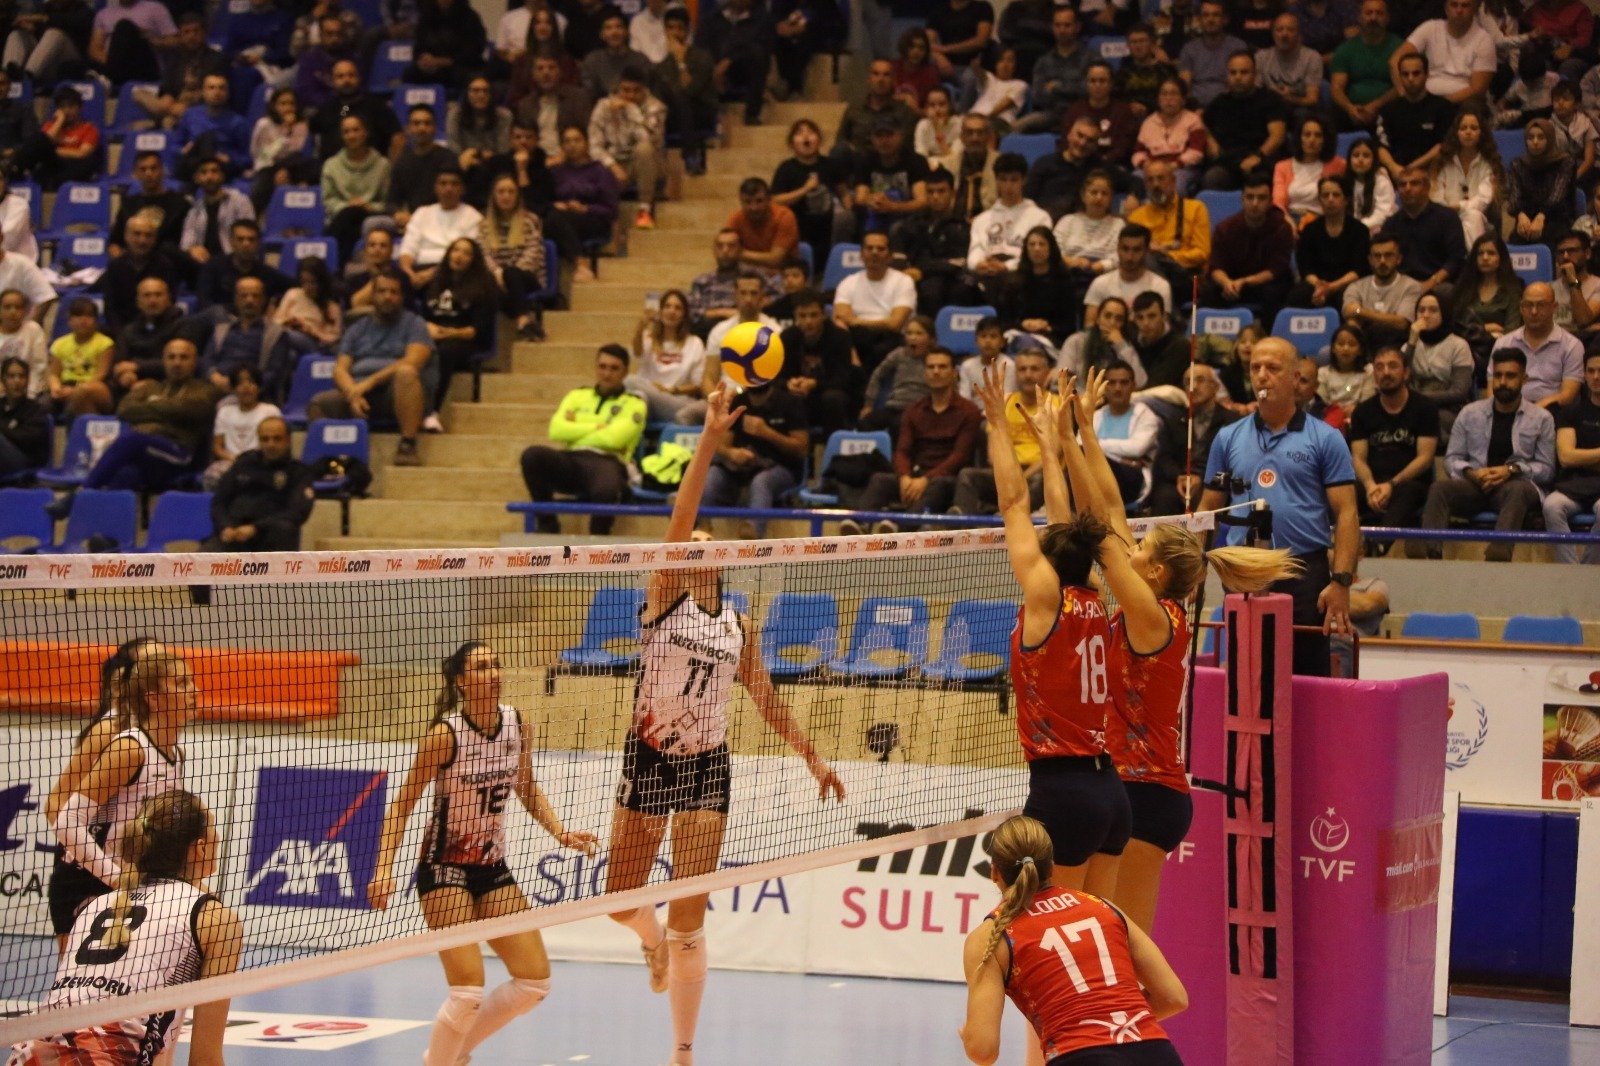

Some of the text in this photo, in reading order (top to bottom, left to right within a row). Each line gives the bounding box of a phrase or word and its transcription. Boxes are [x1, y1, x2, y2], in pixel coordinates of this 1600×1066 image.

[49, 564, 72, 579] TVF
[91, 559, 155, 578] misli.com
[173, 562, 194, 577] TVF
[210, 558, 269, 576] misli.com
[285, 560, 303, 575] TVF
[317, 556, 371, 573] misli.com
[386, 558, 402, 572] TVF
[416, 554, 467, 571] misli.com
[478, 556, 494, 569] TVF
[507, 552, 551, 567] misli.com
[588, 550, 630, 565] misli.com
[642, 551, 655, 564] TVF
[666, 547, 705, 562] misli.com
[737, 544, 773, 558] misli.com
[1075, 634, 1108, 704] 18
[246, 839, 355, 898] AXA
[1299, 856, 1356, 882] TVF
[841, 886, 980, 934] SULT
[1027, 892, 1081, 917] LODA
[75, 904, 148, 965] 8
[1039, 916, 1118, 994] 17
